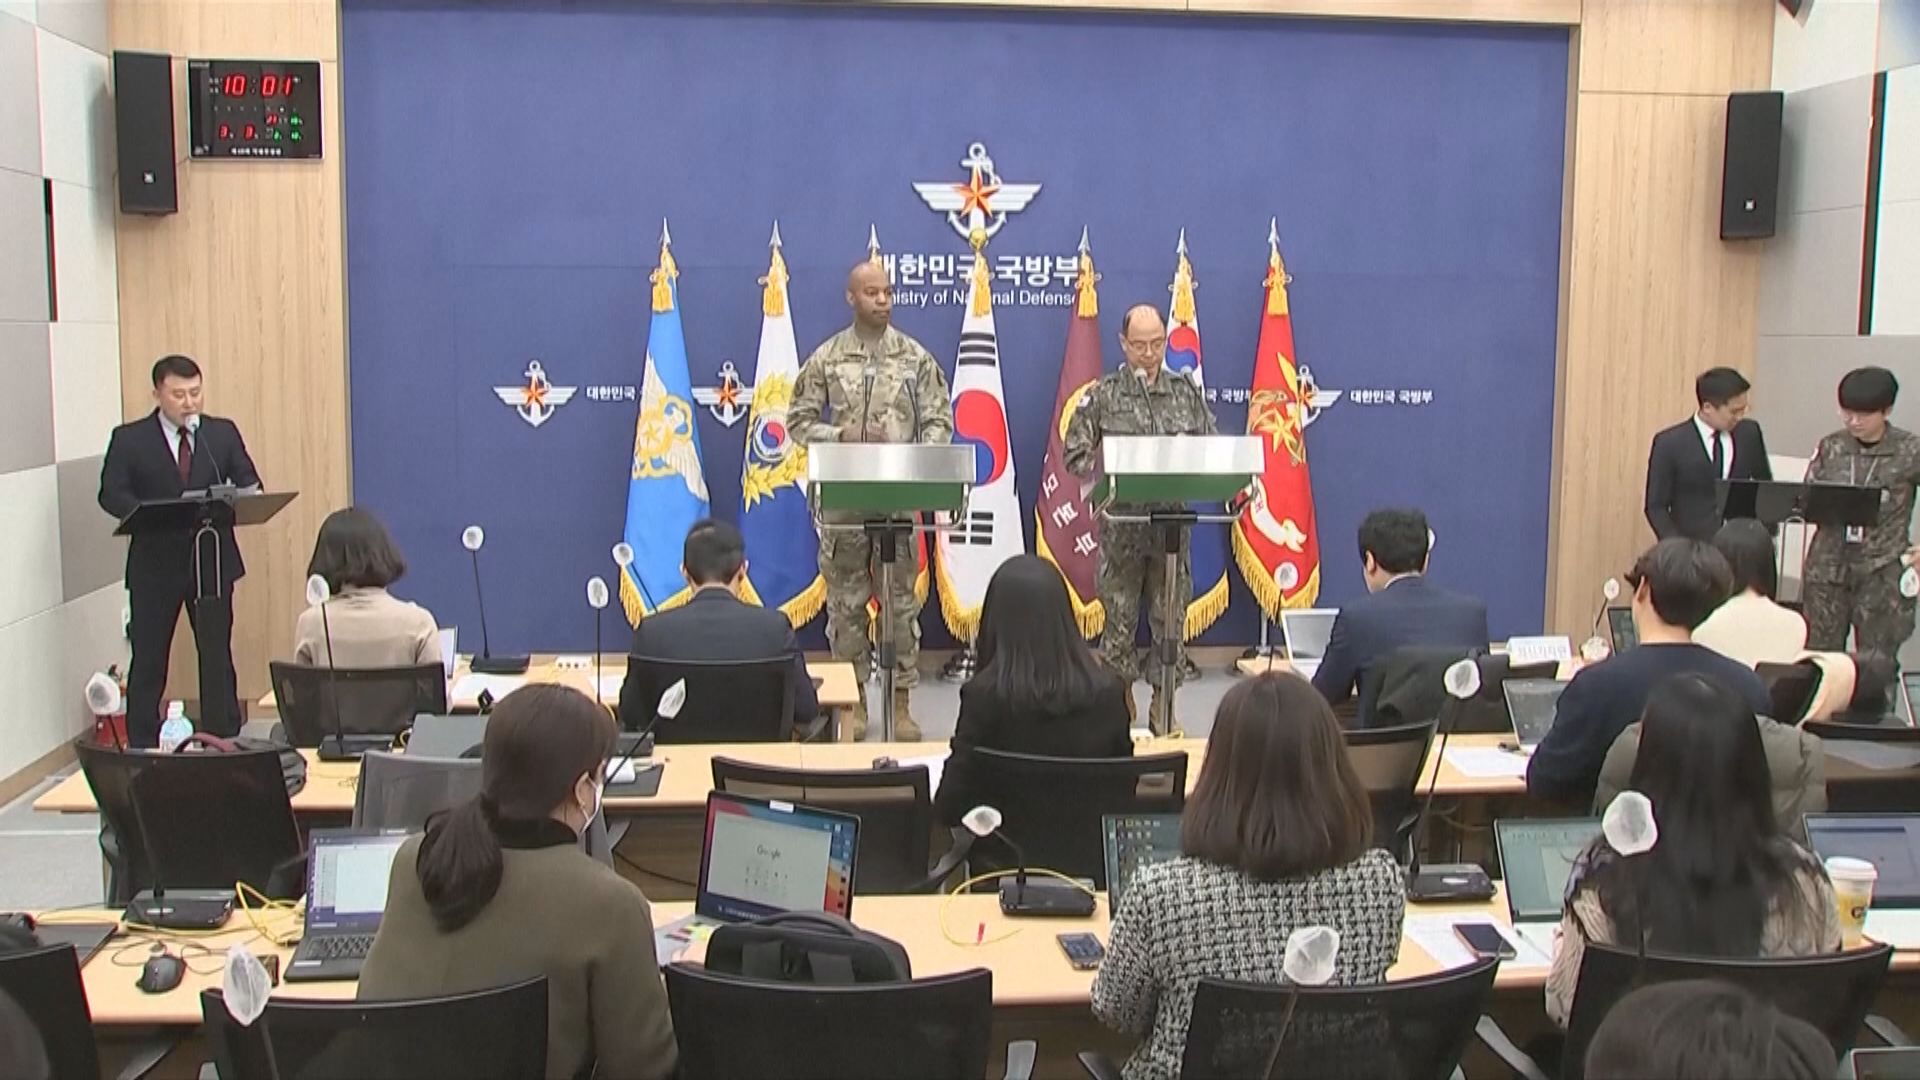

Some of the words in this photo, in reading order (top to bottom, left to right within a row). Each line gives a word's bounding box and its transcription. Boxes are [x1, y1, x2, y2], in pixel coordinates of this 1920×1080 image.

[224, 75, 292, 96] 10:01
[995, 255, 1078, 287] 국방부
[892, 288, 928, 309] istry
[933, 289, 948, 306] of
[953, 289, 1015, 306] Nnal
[586, 385, 636, 401] 대한민국
[1350, 389, 1396, 404] 대한민국
[1398, 389, 1434, 404] 국방부
[1042, 470, 1098, 557] 모본부
